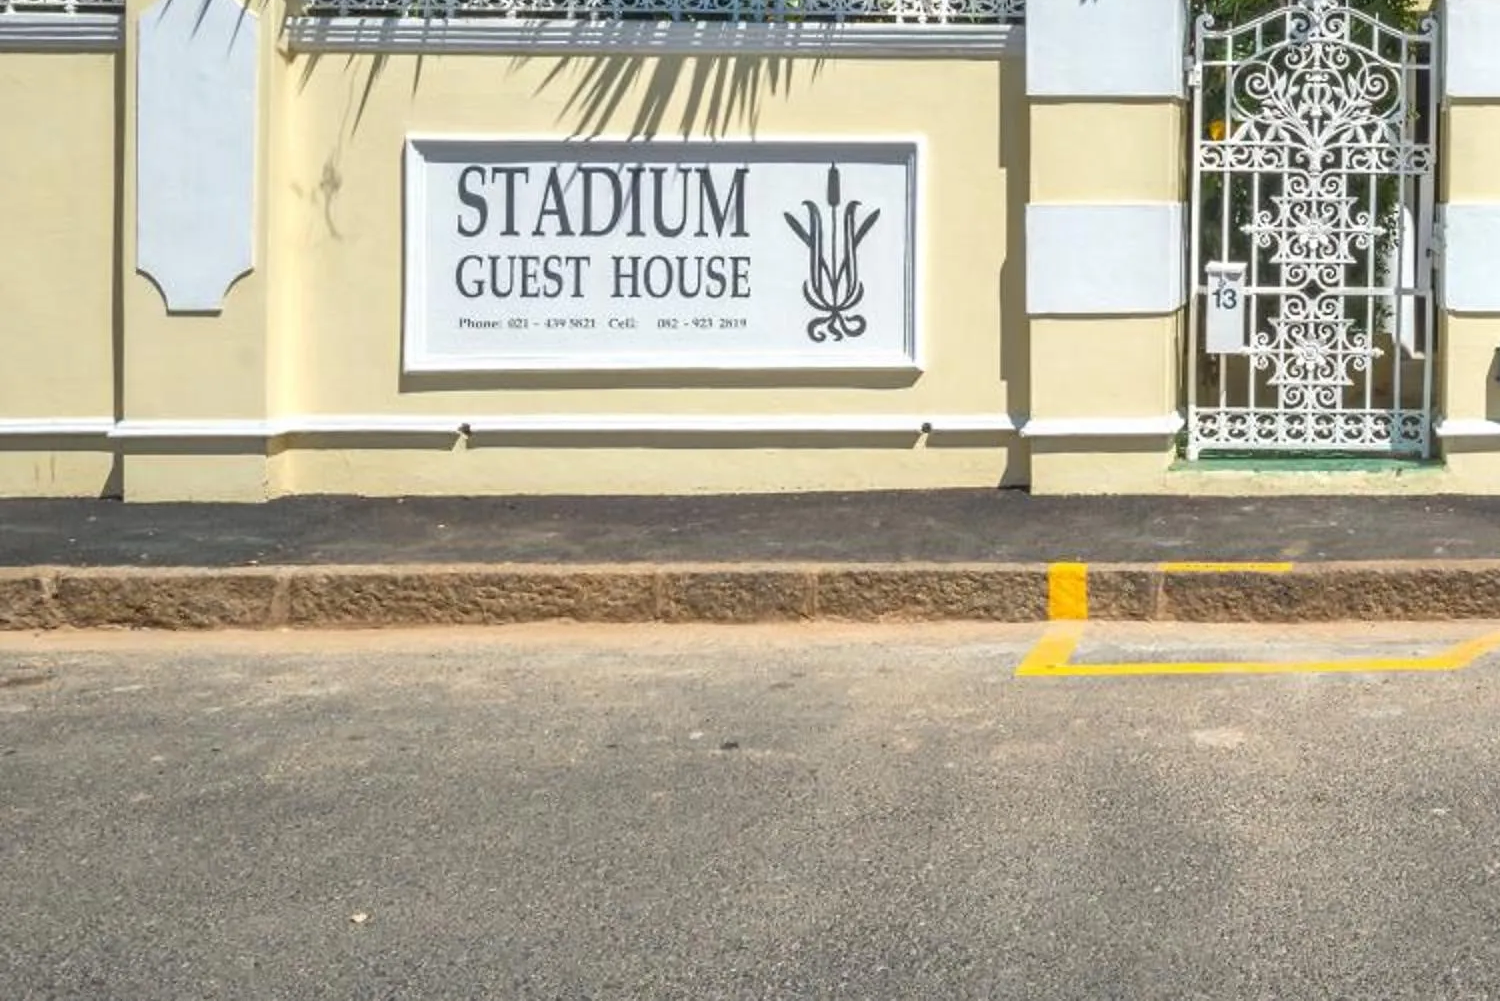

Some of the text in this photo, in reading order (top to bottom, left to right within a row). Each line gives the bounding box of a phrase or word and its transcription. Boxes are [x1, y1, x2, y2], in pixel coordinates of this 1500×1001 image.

[456, 165, 750, 239] STADIUM
[455, 254, 751, 299] GUEST HOUSE
[1211, 288, 1238, 310] 13
[507, 318, 528, 329] 021
